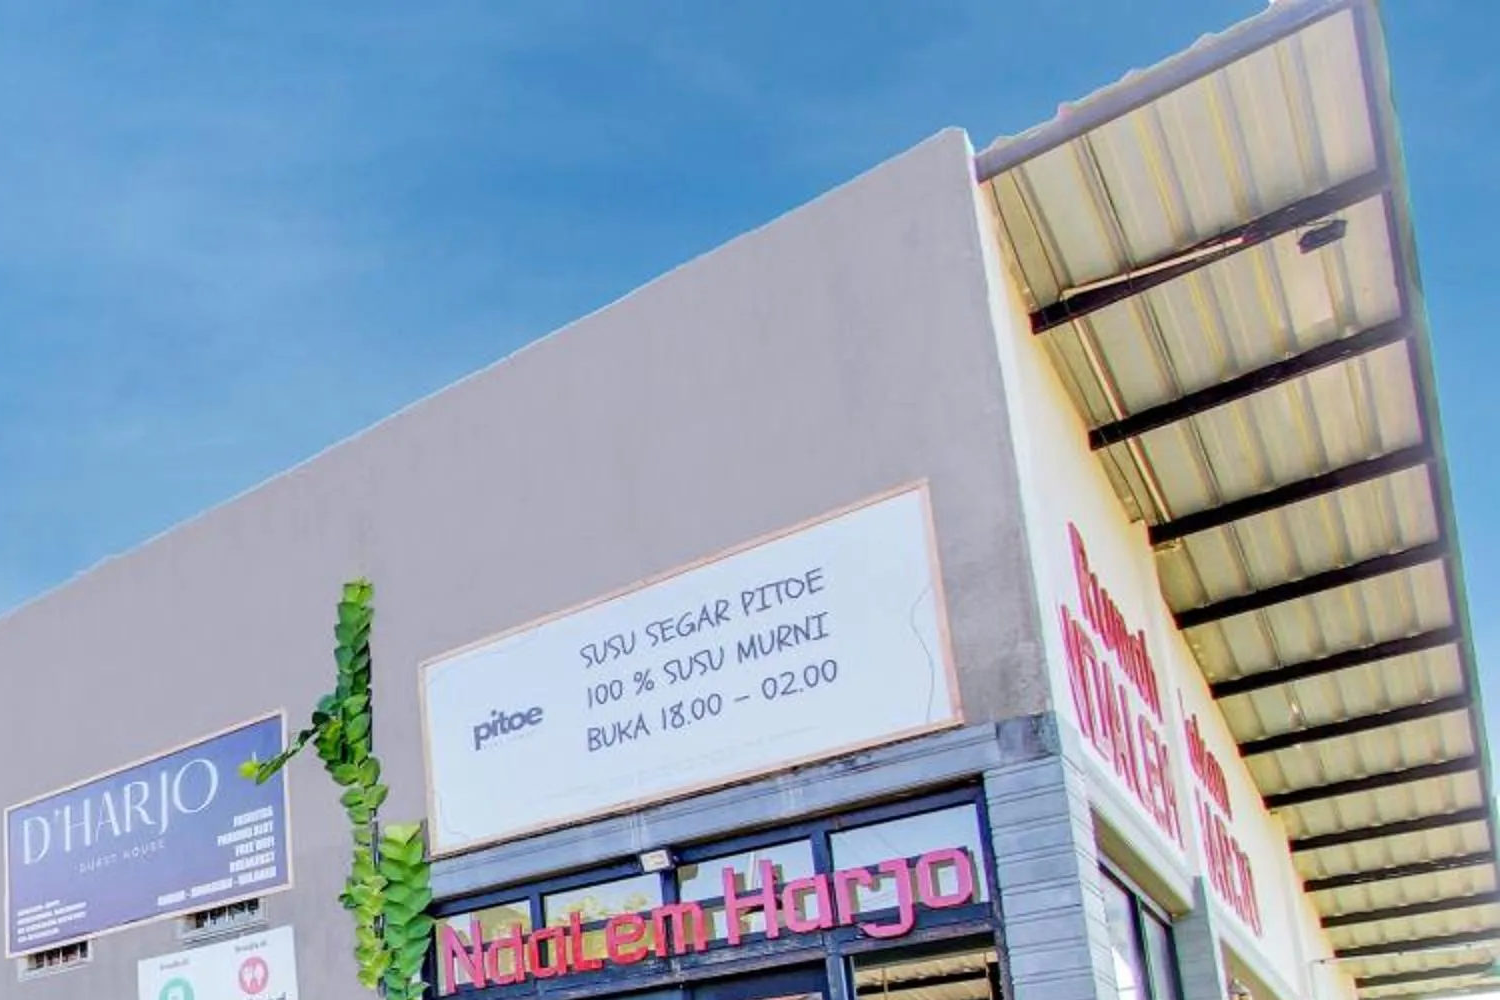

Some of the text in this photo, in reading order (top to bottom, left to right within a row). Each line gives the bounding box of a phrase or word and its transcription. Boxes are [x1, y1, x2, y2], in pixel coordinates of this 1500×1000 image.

[580, 567, 825, 668] SUSU SEGAR PITOE
[587, 611, 829, 708] 100 % SUSU MURNI
[473, 706, 544, 751] pitoe
[587, 712, 651, 752] BUKA
[661, 693, 722, 731] 18.00
[761, 659, 838, 700] 02.00
[23, 758, 219, 866] D'HARJO
[722, 846, 975, 938] Harjo
